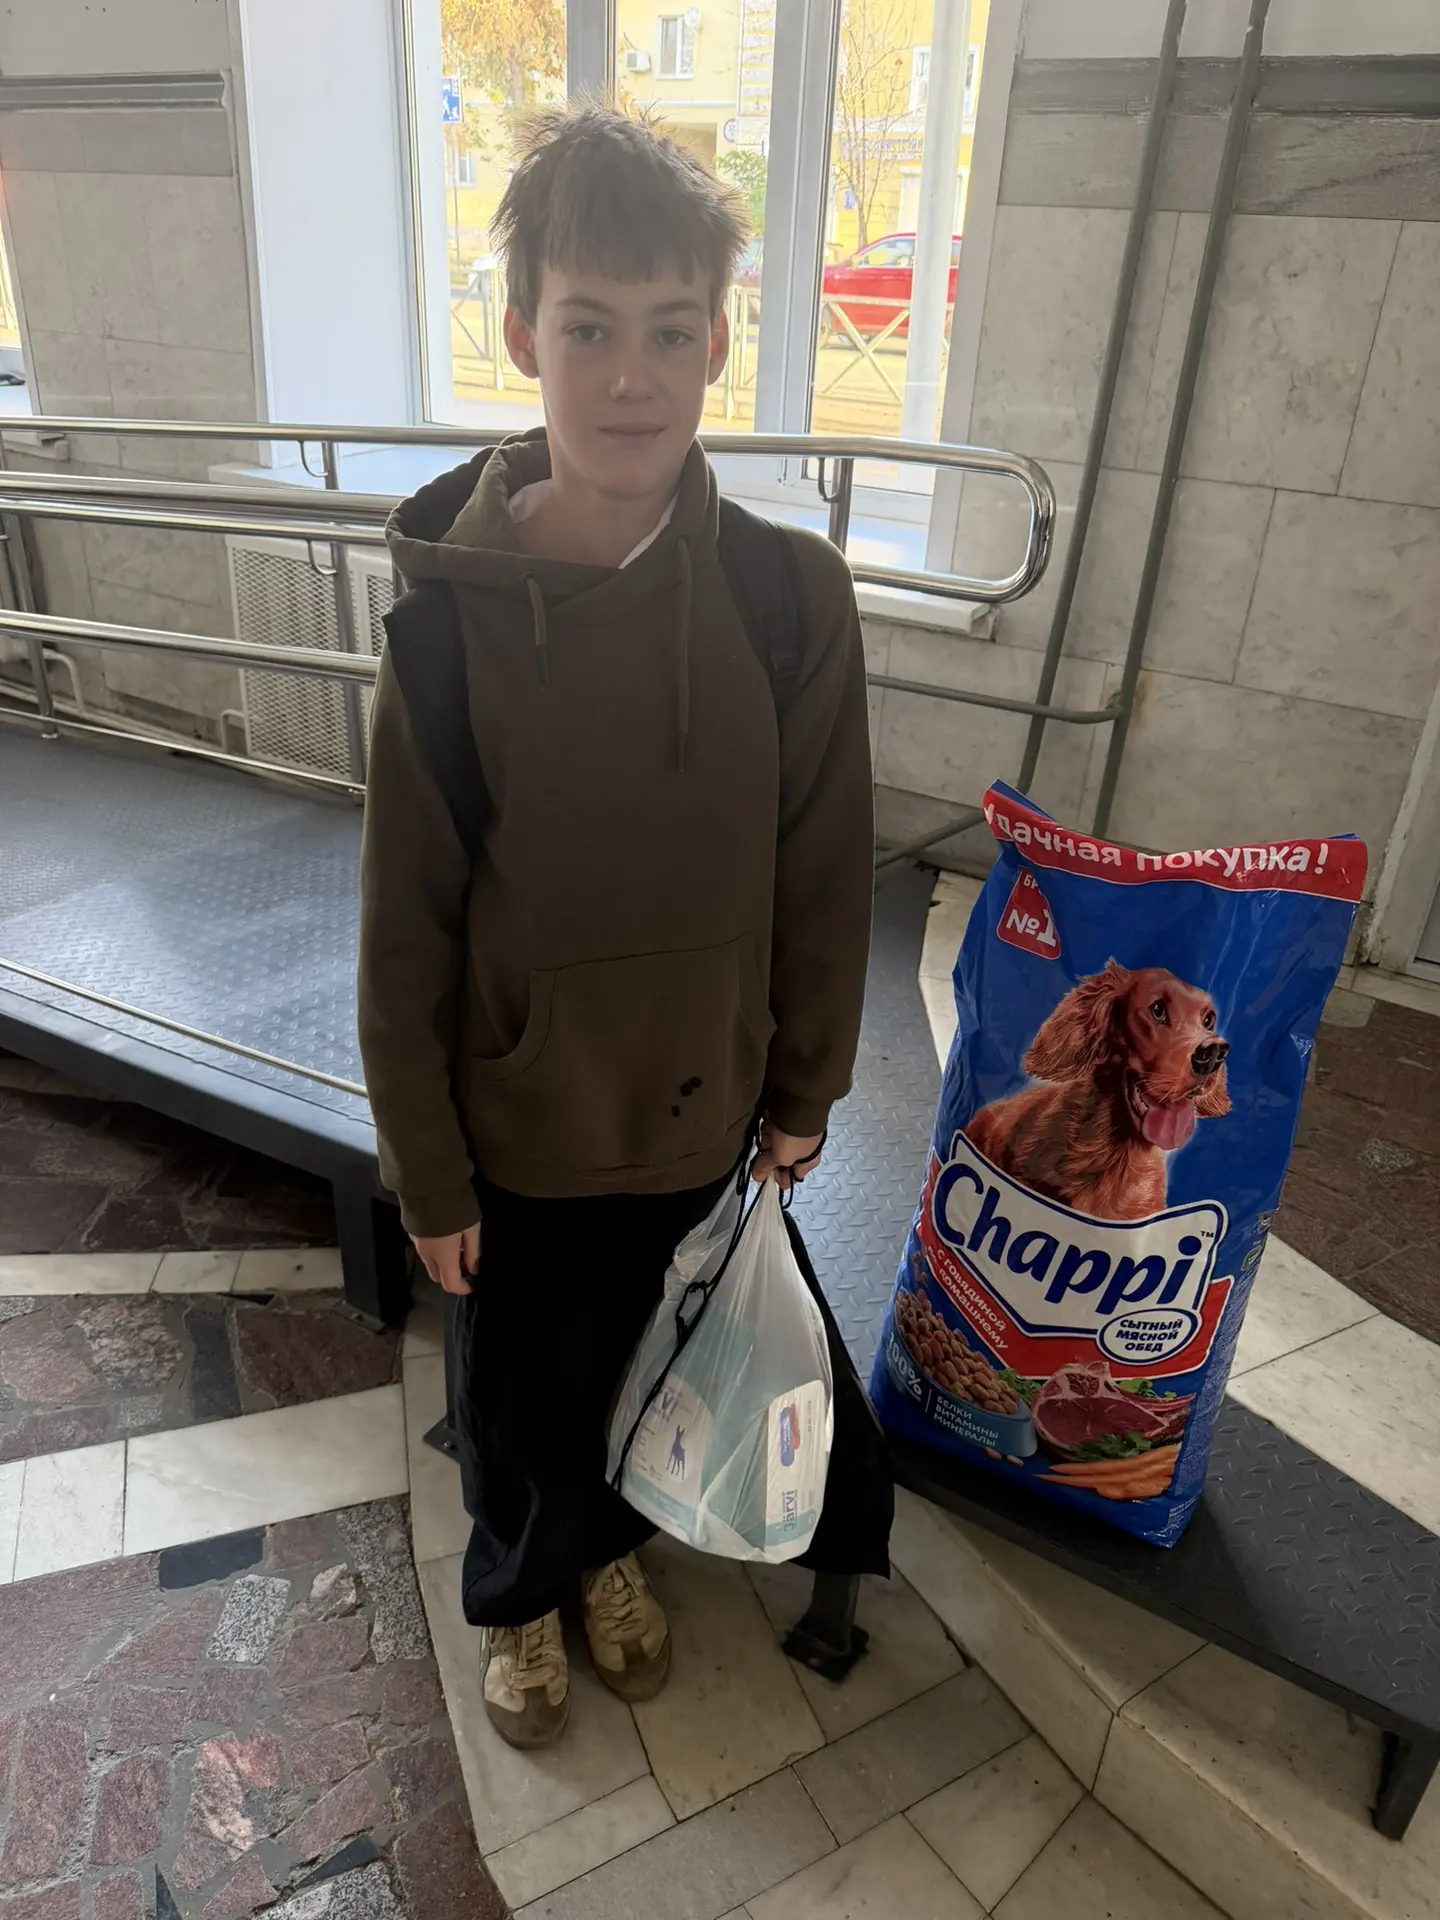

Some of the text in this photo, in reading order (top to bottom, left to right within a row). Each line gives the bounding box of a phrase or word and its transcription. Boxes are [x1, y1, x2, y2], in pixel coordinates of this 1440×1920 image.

[1137, 843, 1329, 877] покупка!
[935, 1163, 1202, 1315] Chappi
[944, 1258, 1007, 1332] говядиной
[1115, 1330, 1178, 1341] МЯСНОЙ
[1120, 1318, 1183, 1331] СЫТНЫЙ
[1124, 1342, 1163, 1352] ОБЕД
[935, 1404, 999, 1438] ВИТАМИНЫ
[937, 1396, 972, 1419] БЕЛКИ
[933, 1413, 996, 1446] МИНЕРАЛЫ
